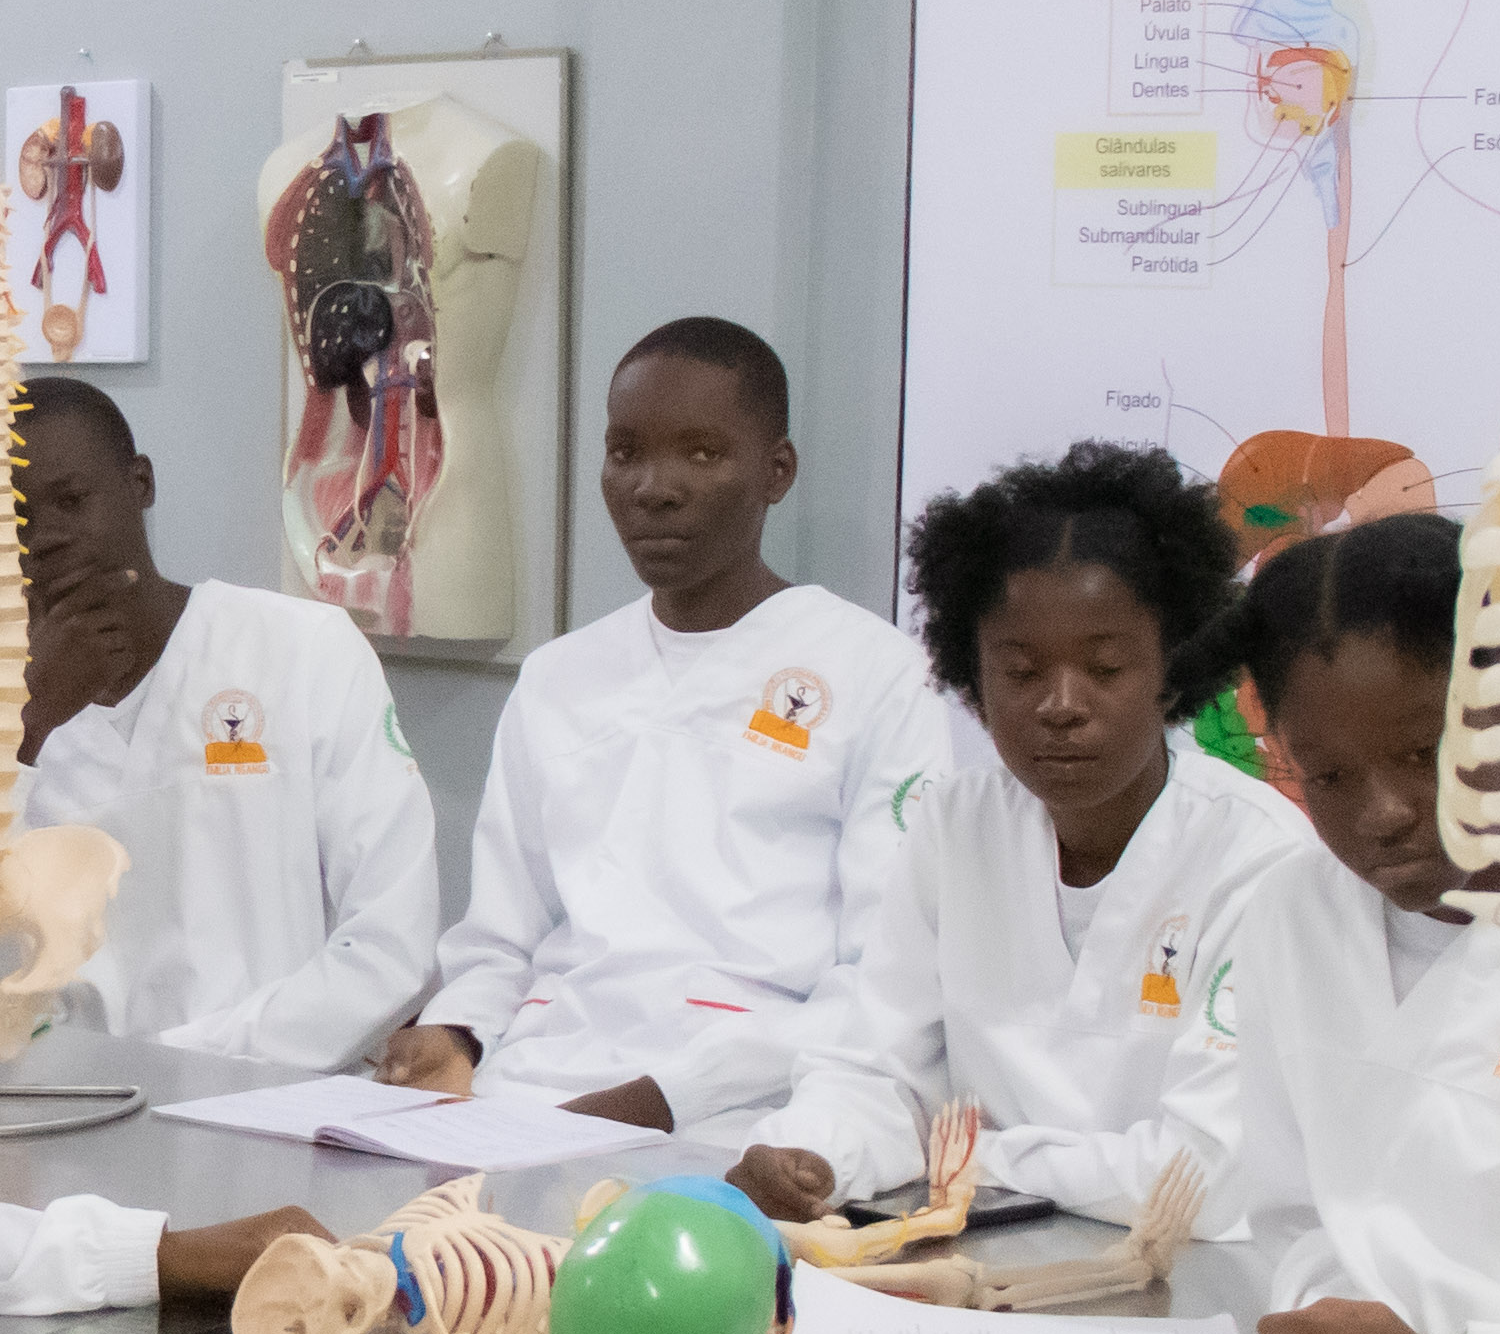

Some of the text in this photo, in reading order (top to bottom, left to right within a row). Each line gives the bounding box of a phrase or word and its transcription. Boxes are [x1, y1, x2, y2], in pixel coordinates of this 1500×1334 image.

[1144, 19, 1190, 41] Úvula
[1134, 52, 1190, 73] Língua
[1132, 81, 1190, 98] Dentes
[1096, 137, 1176, 154] Glândulas
[1100, 159, 1171, 177] salivares
[1117, 199, 1202, 220] Sublingual
[1079, 226, 1200, 244] Submandibular
[1131, 255, 1199, 273] Parótida
